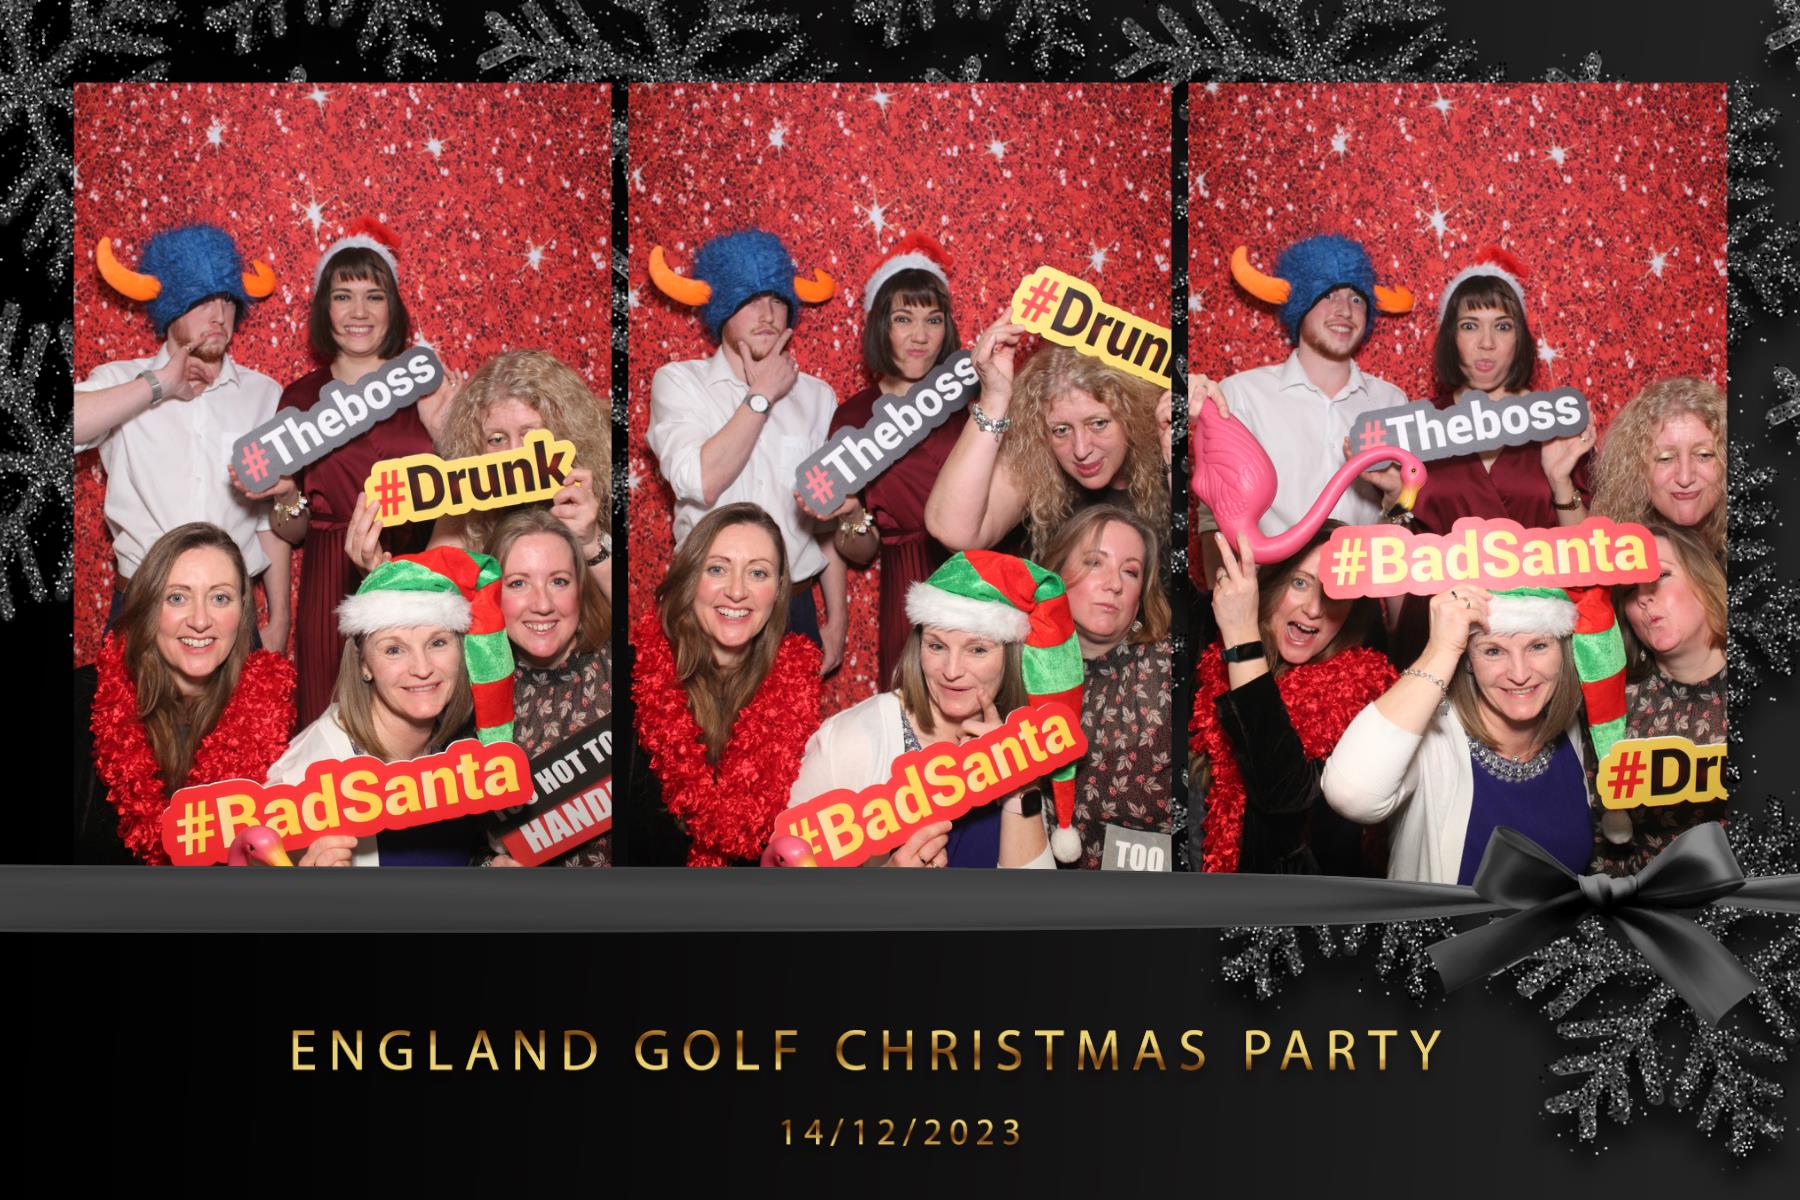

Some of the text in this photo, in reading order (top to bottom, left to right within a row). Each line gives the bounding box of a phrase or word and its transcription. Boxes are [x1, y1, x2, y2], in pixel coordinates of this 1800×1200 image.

[1020, 277, 1172, 379] #Drun
[241, 354, 436, 482] #Theboss
[805, 357, 979, 505] #Theboss
[1359, 396, 1581, 452] #Theboss
[374, 441, 568, 516] #Drunk
[1331, 529, 1649, 586] #BadSanta
[176, 753, 521, 856] #BadSanta
[534, 749, 587, 795] HOT
[520, 780, 612, 854] HAND
[1115, 840, 1164, 872] TOO
